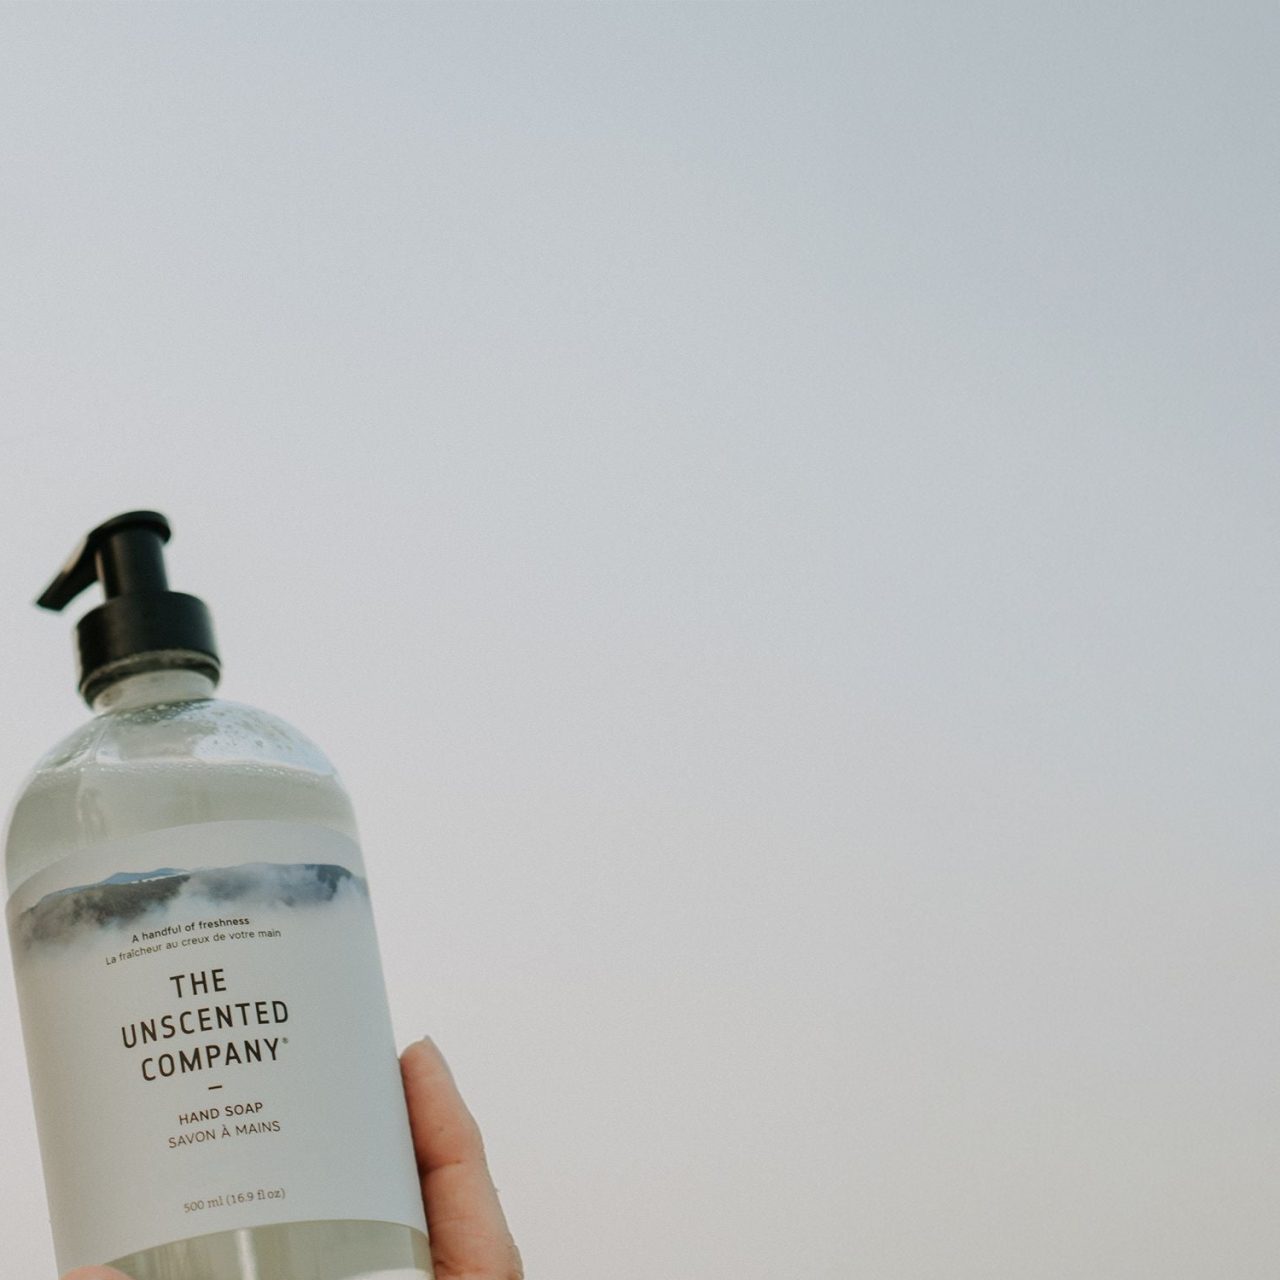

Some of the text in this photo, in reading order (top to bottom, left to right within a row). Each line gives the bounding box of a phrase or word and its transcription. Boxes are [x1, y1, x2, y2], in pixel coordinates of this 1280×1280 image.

[131, 917, 250, 943] A handful of freshness
[105, 956, 117, 966] La
[166, 940, 178, 950] au
[182, 935, 210, 947] creux
[213, 932, 226, 942] de
[229, 930, 255, 940] votre
[258, 928, 282, 938] main
[170, 968, 226, 998] THE
[122, 1001, 288, 1048] UNSCENTED
[178, 1102, 264, 1125] HAND SOAP
[168, 1120, 281, 1148] SAVON À MAINS
[184, 1201, 205, 1213] 500
[208, 1196, 224, 1208] ml
